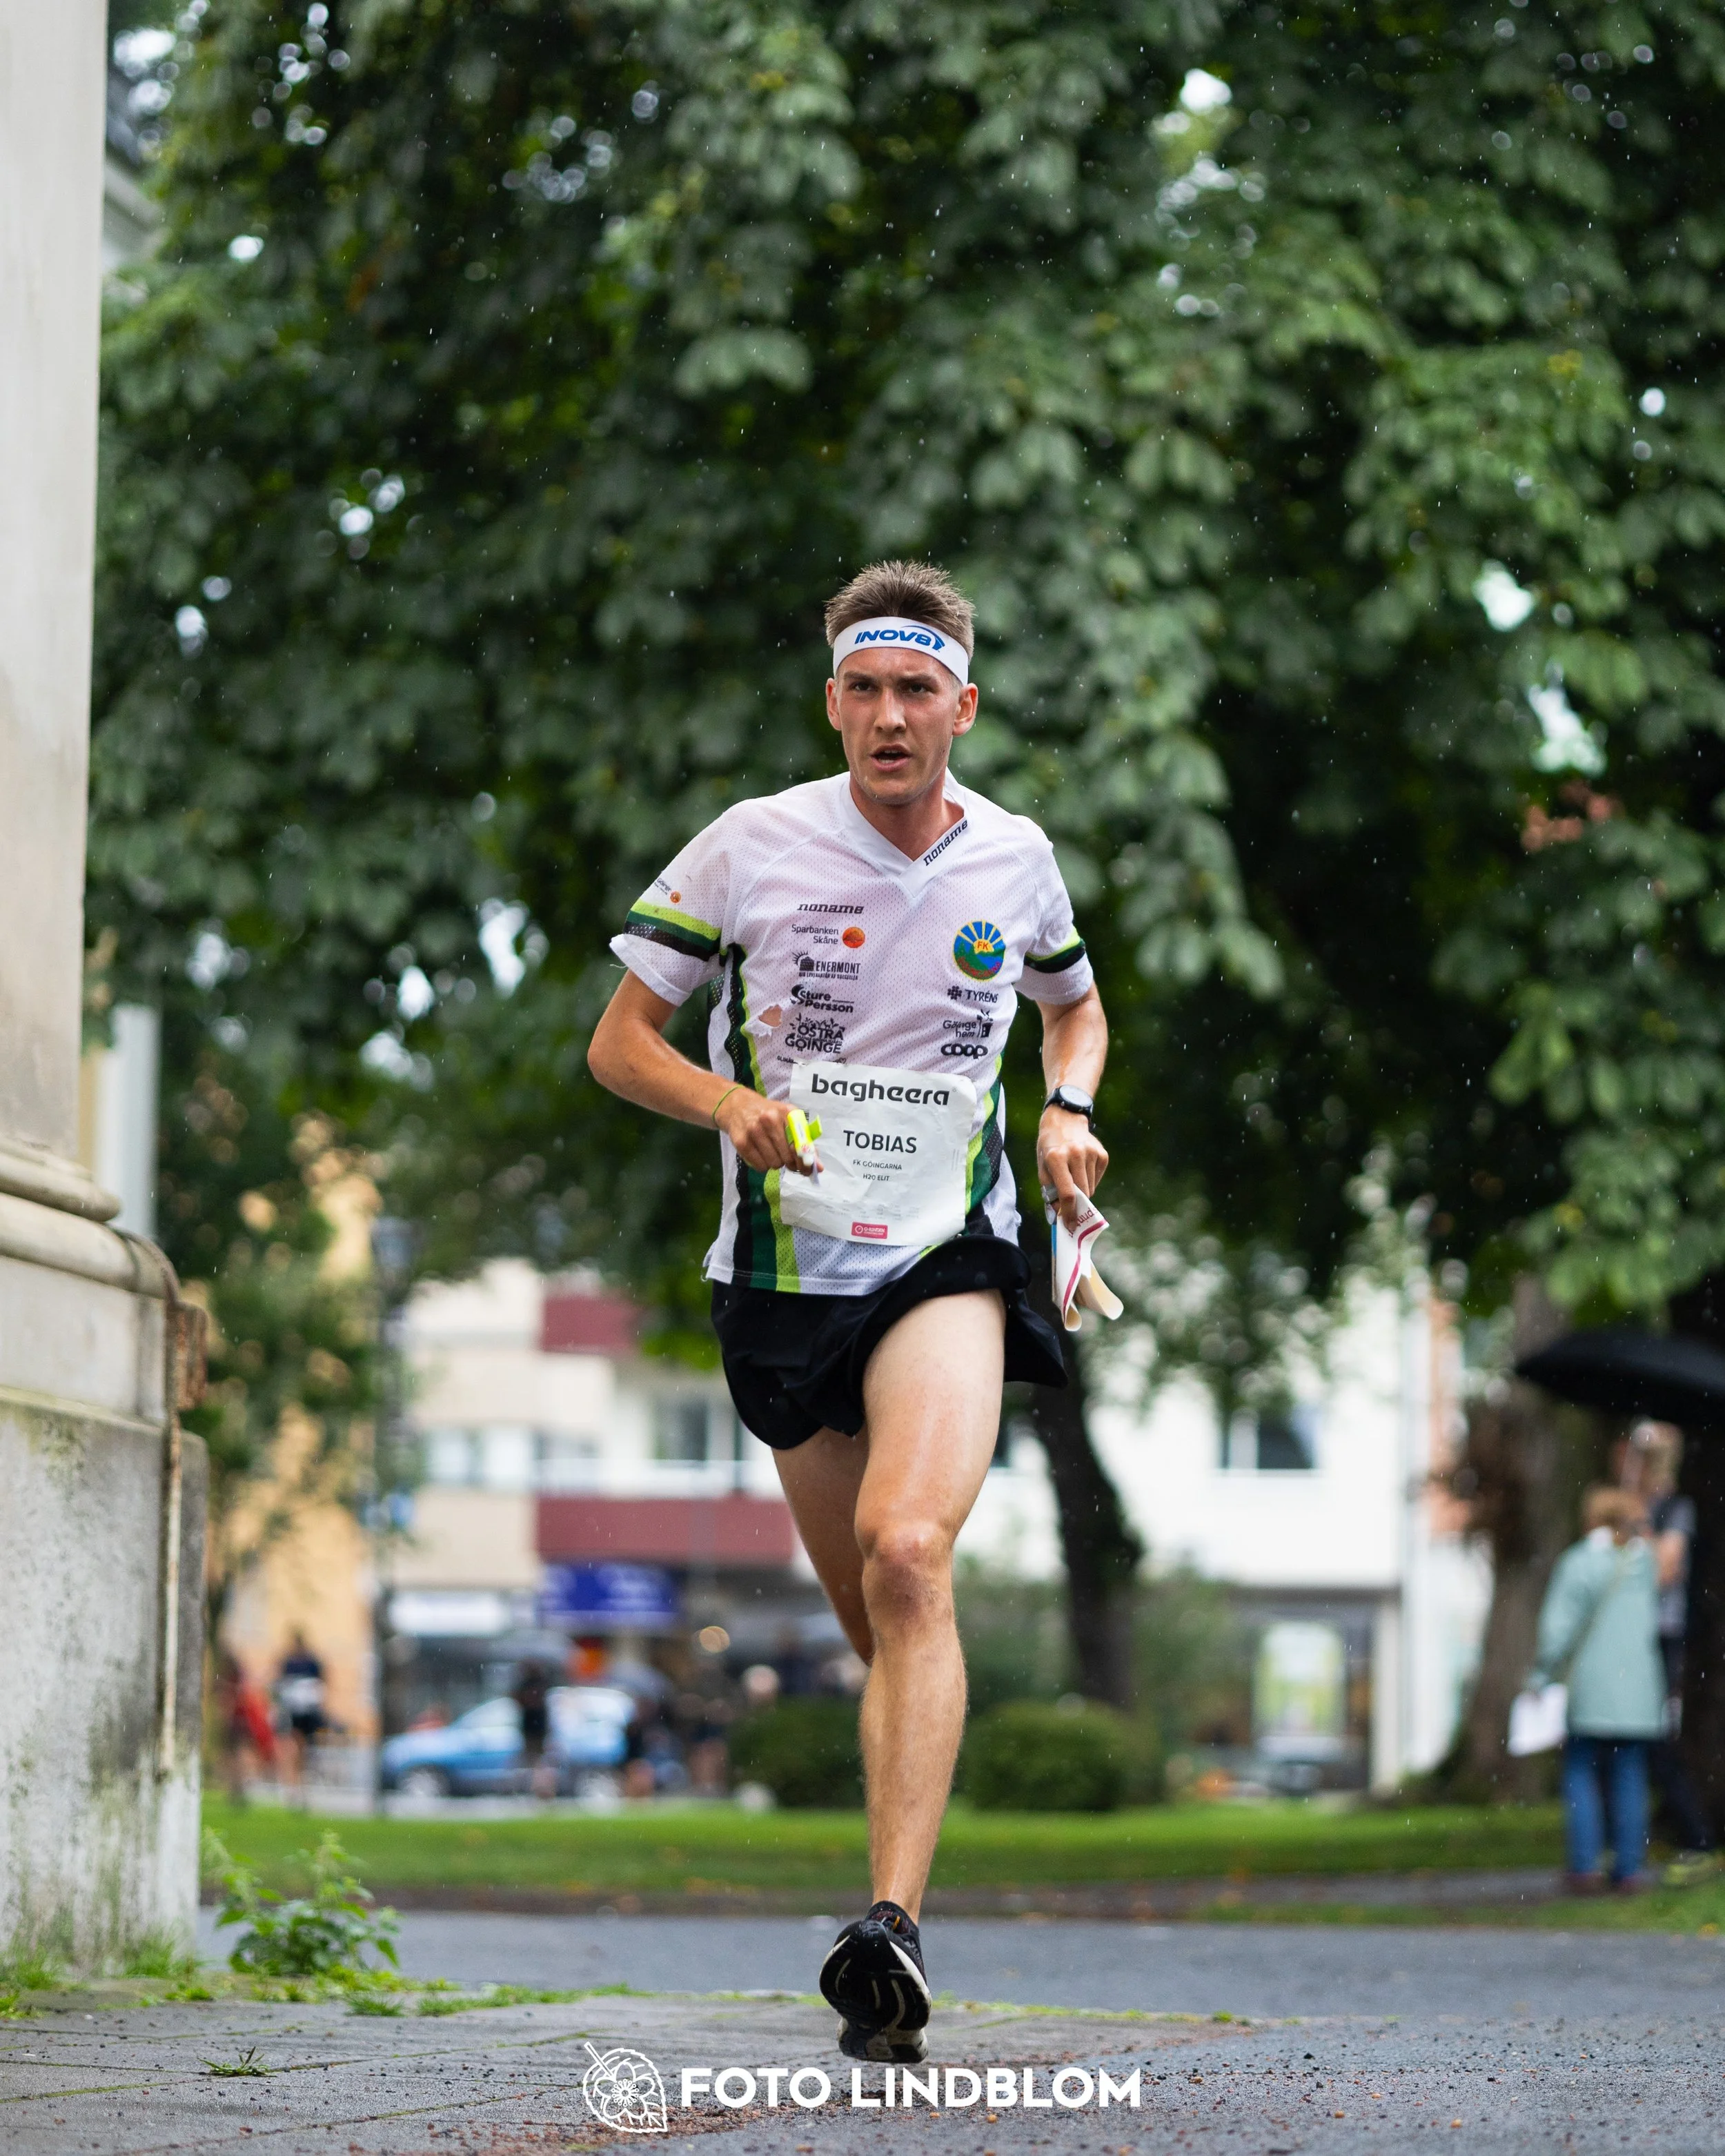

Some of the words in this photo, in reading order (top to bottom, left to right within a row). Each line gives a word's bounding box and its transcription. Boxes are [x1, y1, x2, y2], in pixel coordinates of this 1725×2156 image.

[854, 629, 934, 647] INOV8
[923, 820, 967, 867] noname
[797, 904, 864, 914] noname
[791, 924, 839, 936] Sparbanken
[813, 936, 838, 945] Skåne
[977, 941, 989, 950] FK
[816, 961, 861, 973] ENERMONT
[800, 990, 831, 1001] Sture
[965, 989, 998, 1003] TYRÉNS
[805, 999, 854, 1013] Persson
[798, 1022, 844, 1040] ÖSTRA
[943, 1020, 977, 1031] Göinge
[956, 1027, 975, 1038] hem
[940, 1043, 988, 1059] coop
[811, 1074, 950, 1105] bagheera
[843, 1130, 917, 1154] TOBIAS
